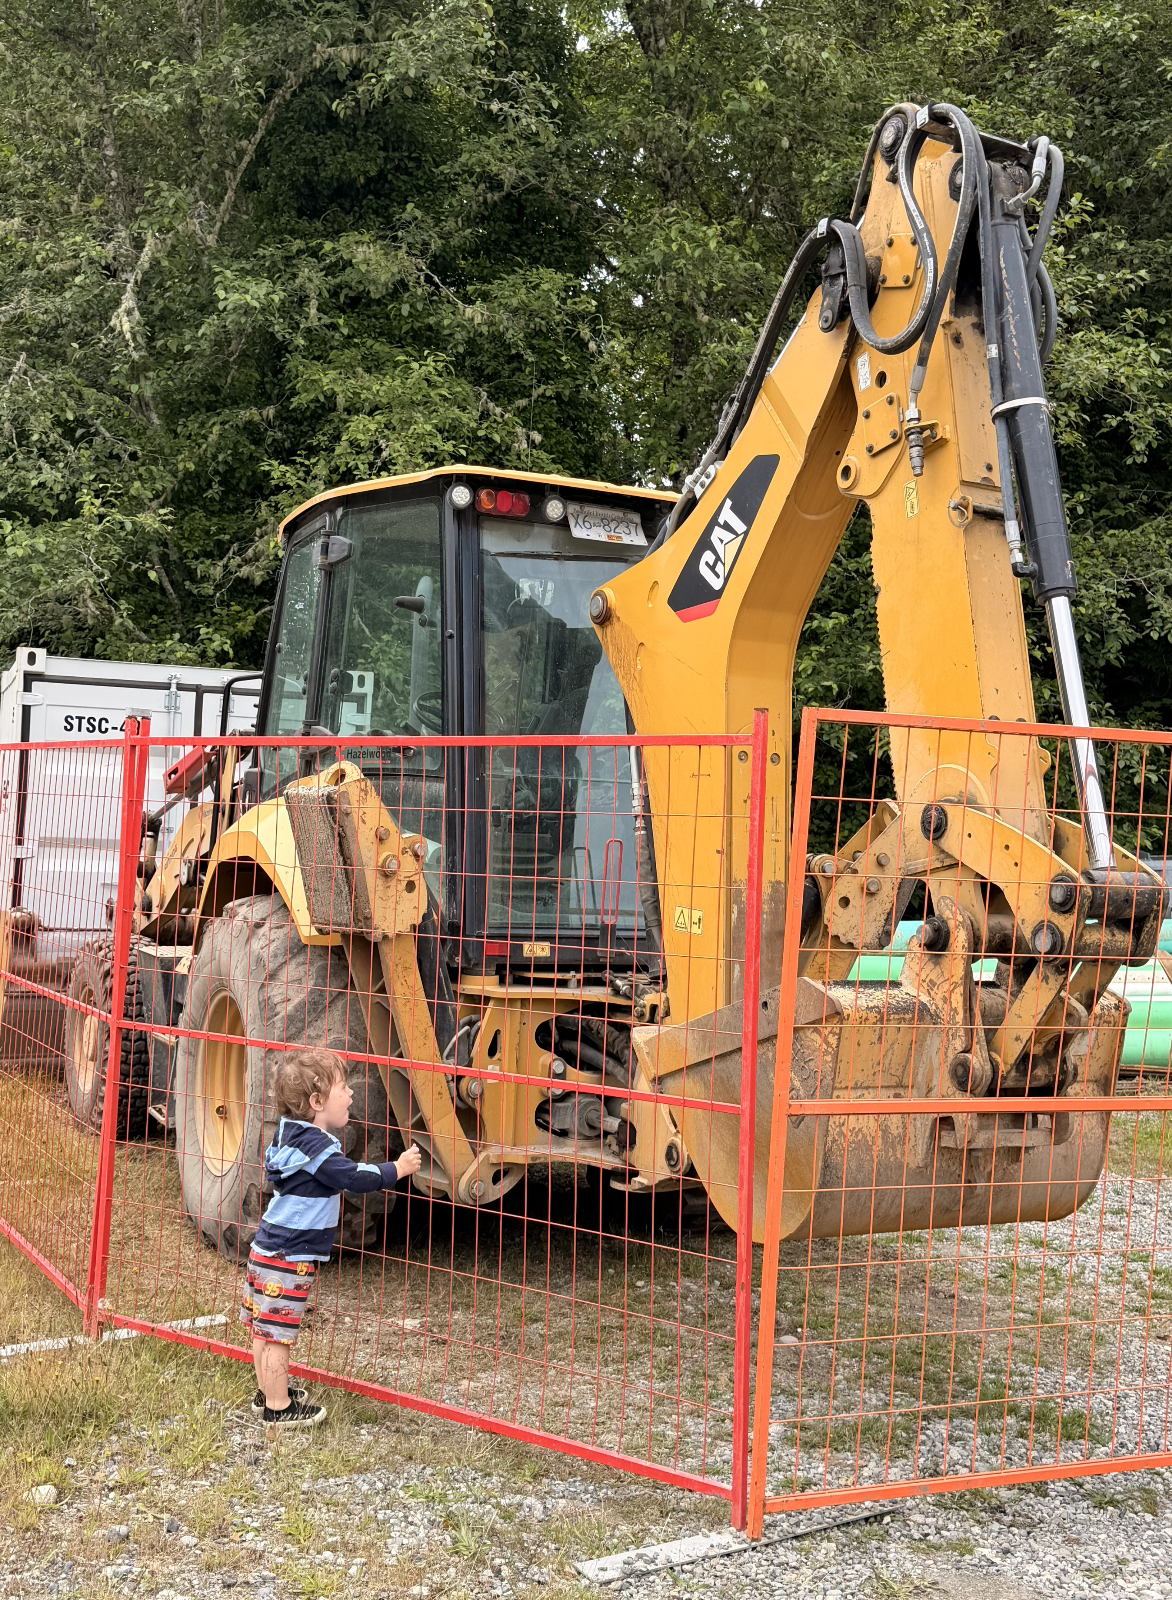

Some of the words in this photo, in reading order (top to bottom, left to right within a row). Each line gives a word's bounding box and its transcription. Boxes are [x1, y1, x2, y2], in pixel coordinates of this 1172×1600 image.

[600, 517, 639, 536] 8237
[699, 498, 747, 590] CAT
[346, 748, 392, 759] Hazelwood
[265, 1281, 281, 1297] 95
